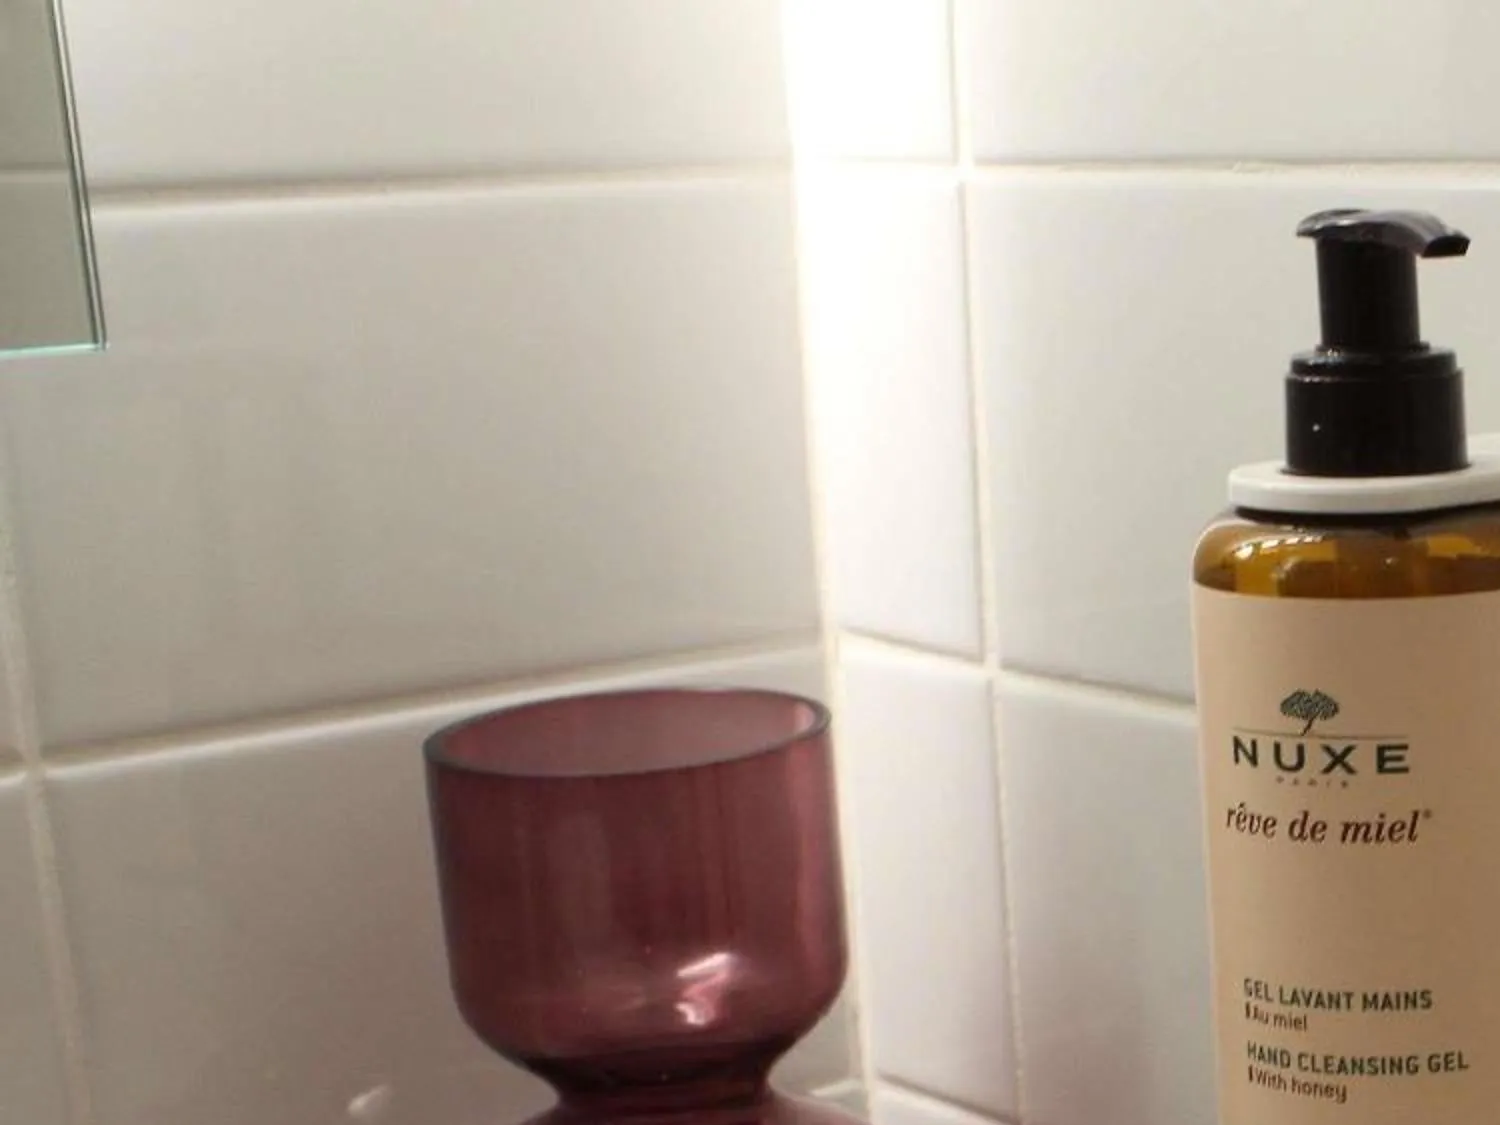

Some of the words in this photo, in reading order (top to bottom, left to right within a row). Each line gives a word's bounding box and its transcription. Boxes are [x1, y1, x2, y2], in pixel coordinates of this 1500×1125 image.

[1232, 735, 1410, 775] NUXE
[1226, 802, 1278, 838] rêve
[1288, 810, 1328, 843] de
[1243, 977, 1274, 1003] GEL
[1278, 985, 1355, 1011] LAVANT
[1361, 989, 1433, 1013] MAINS
[1273, 1012, 1308, 1031] miel
[1246, 1039, 1292, 1069] HAND
[1297, 1052, 1420, 1077] CLEANSING
[1427, 1051, 1470, 1073] GEL
[1255, 1068, 1288, 1093] With
[1290, 1074, 1348, 1104] honey
